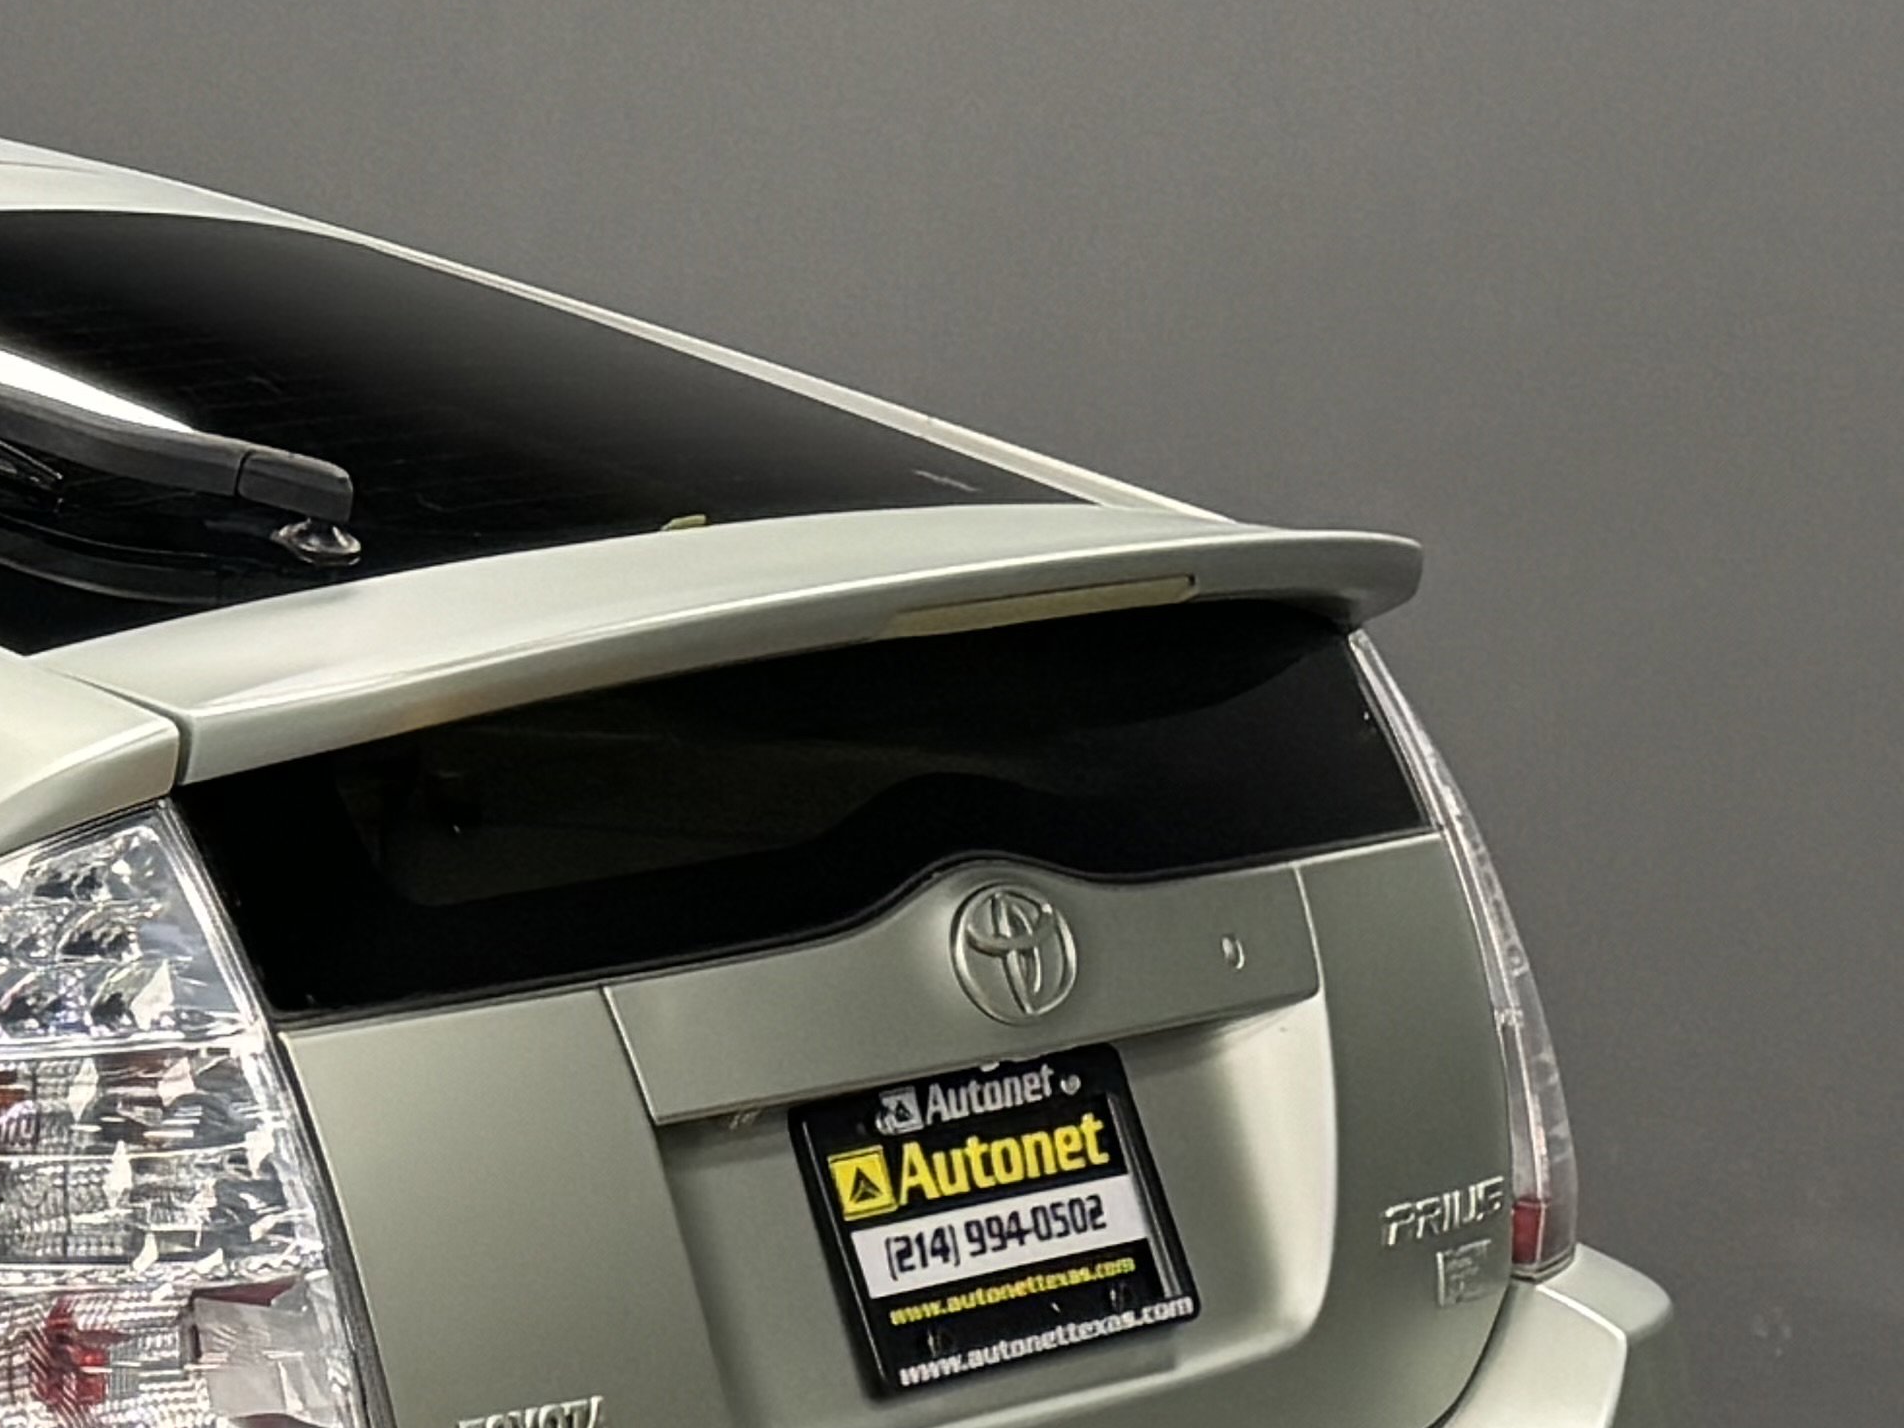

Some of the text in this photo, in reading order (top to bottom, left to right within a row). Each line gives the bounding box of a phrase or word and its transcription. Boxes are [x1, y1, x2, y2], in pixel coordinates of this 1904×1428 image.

[926, 1063, 1055, 1126] Autonet
[899, 1112, 1110, 1206] Autonet
[884, 1193, 1107, 1281] (214) 994-0502
[1381, 1175, 1505, 1247] PRIUS
[889, 1256, 1137, 1326] www.autonettexas.com
[898, 1295, 1193, 1388] www.autonettexas.com
